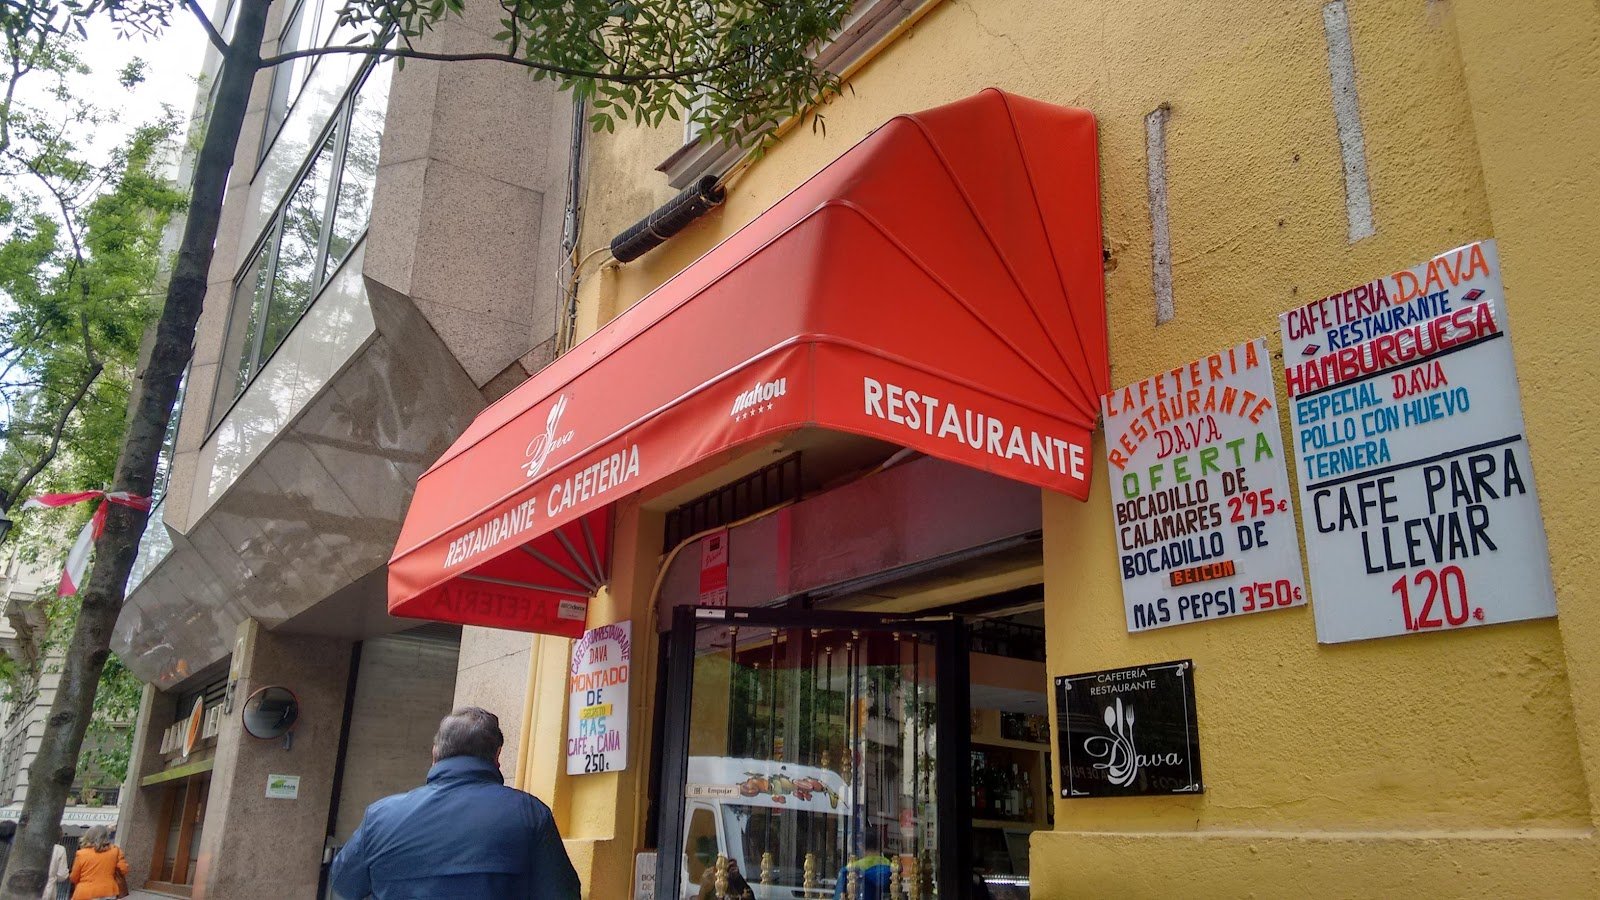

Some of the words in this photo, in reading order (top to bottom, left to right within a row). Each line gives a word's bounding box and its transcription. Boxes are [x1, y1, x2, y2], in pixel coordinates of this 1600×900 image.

[1287, 279, 1391, 341] CAFETERIA
[1391, 244, 1490, 304] DAVA
[1327, 289, 1452, 351] RESTAURANTE
[1285, 301, 1498, 398] HAMBURGUESA
[730, 377, 787, 416] Mahou
[1105, 340, 1259, 418] CAFETERIA
[1296, 382, 1383, 426] ESPECIAL
[1391, 360, 1448, 399] DAVA
[863, 376, 1085, 481] RESTAURANTE
[1108, 385, 1272, 471] RESTAURANTE
[1154, 414, 1222, 459] DAVA
[1300, 417, 1356, 453] POLLO
[1361, 405, 1399, 437] CON
[1403, 386, 1470, 427] HUEVO
[521, 430, 575, 473] Dava
[1122, 432, 1274, 498] OFERTA
[1303, 437, 1391, 480] TERNERA
[443, 497, 537, 568] RESTAURANTE
[547, 444, 640, 518] CAFETERIA
[1116, 479, 1209, 526] BOCADILLO
[1222, 467, 1249, 497] DE
[1313, 476, 1399, 534] CAFE
[1423, 448, 1526, 515] PARA
[1120, 502, 1222, 551] CALAMARES
[1122, 531, 1224, 580] BOCADILLO
[1237, 520, 1269, 552] DE
[1361, 504, 1498, 574] LLEVAR
[1173, 560, 1235, 585] BEICON
[1133, 598, 1171, 629] MAS
[1178, 587, 1236, 621] PEPSI
[589, 644, 608, 664] DAVA
[570, 665, 628, 693] MONTADO
[587, 688, 603, 706] DE
[1090, 680, 1156, 696] RESTAURANTE
[579, 717, 606, 737] MAS
[597, 729, 621, 753] CAÑA
[1084, 735, 1184, 774] Dava
[708, 787, 732, 795] Empujar
